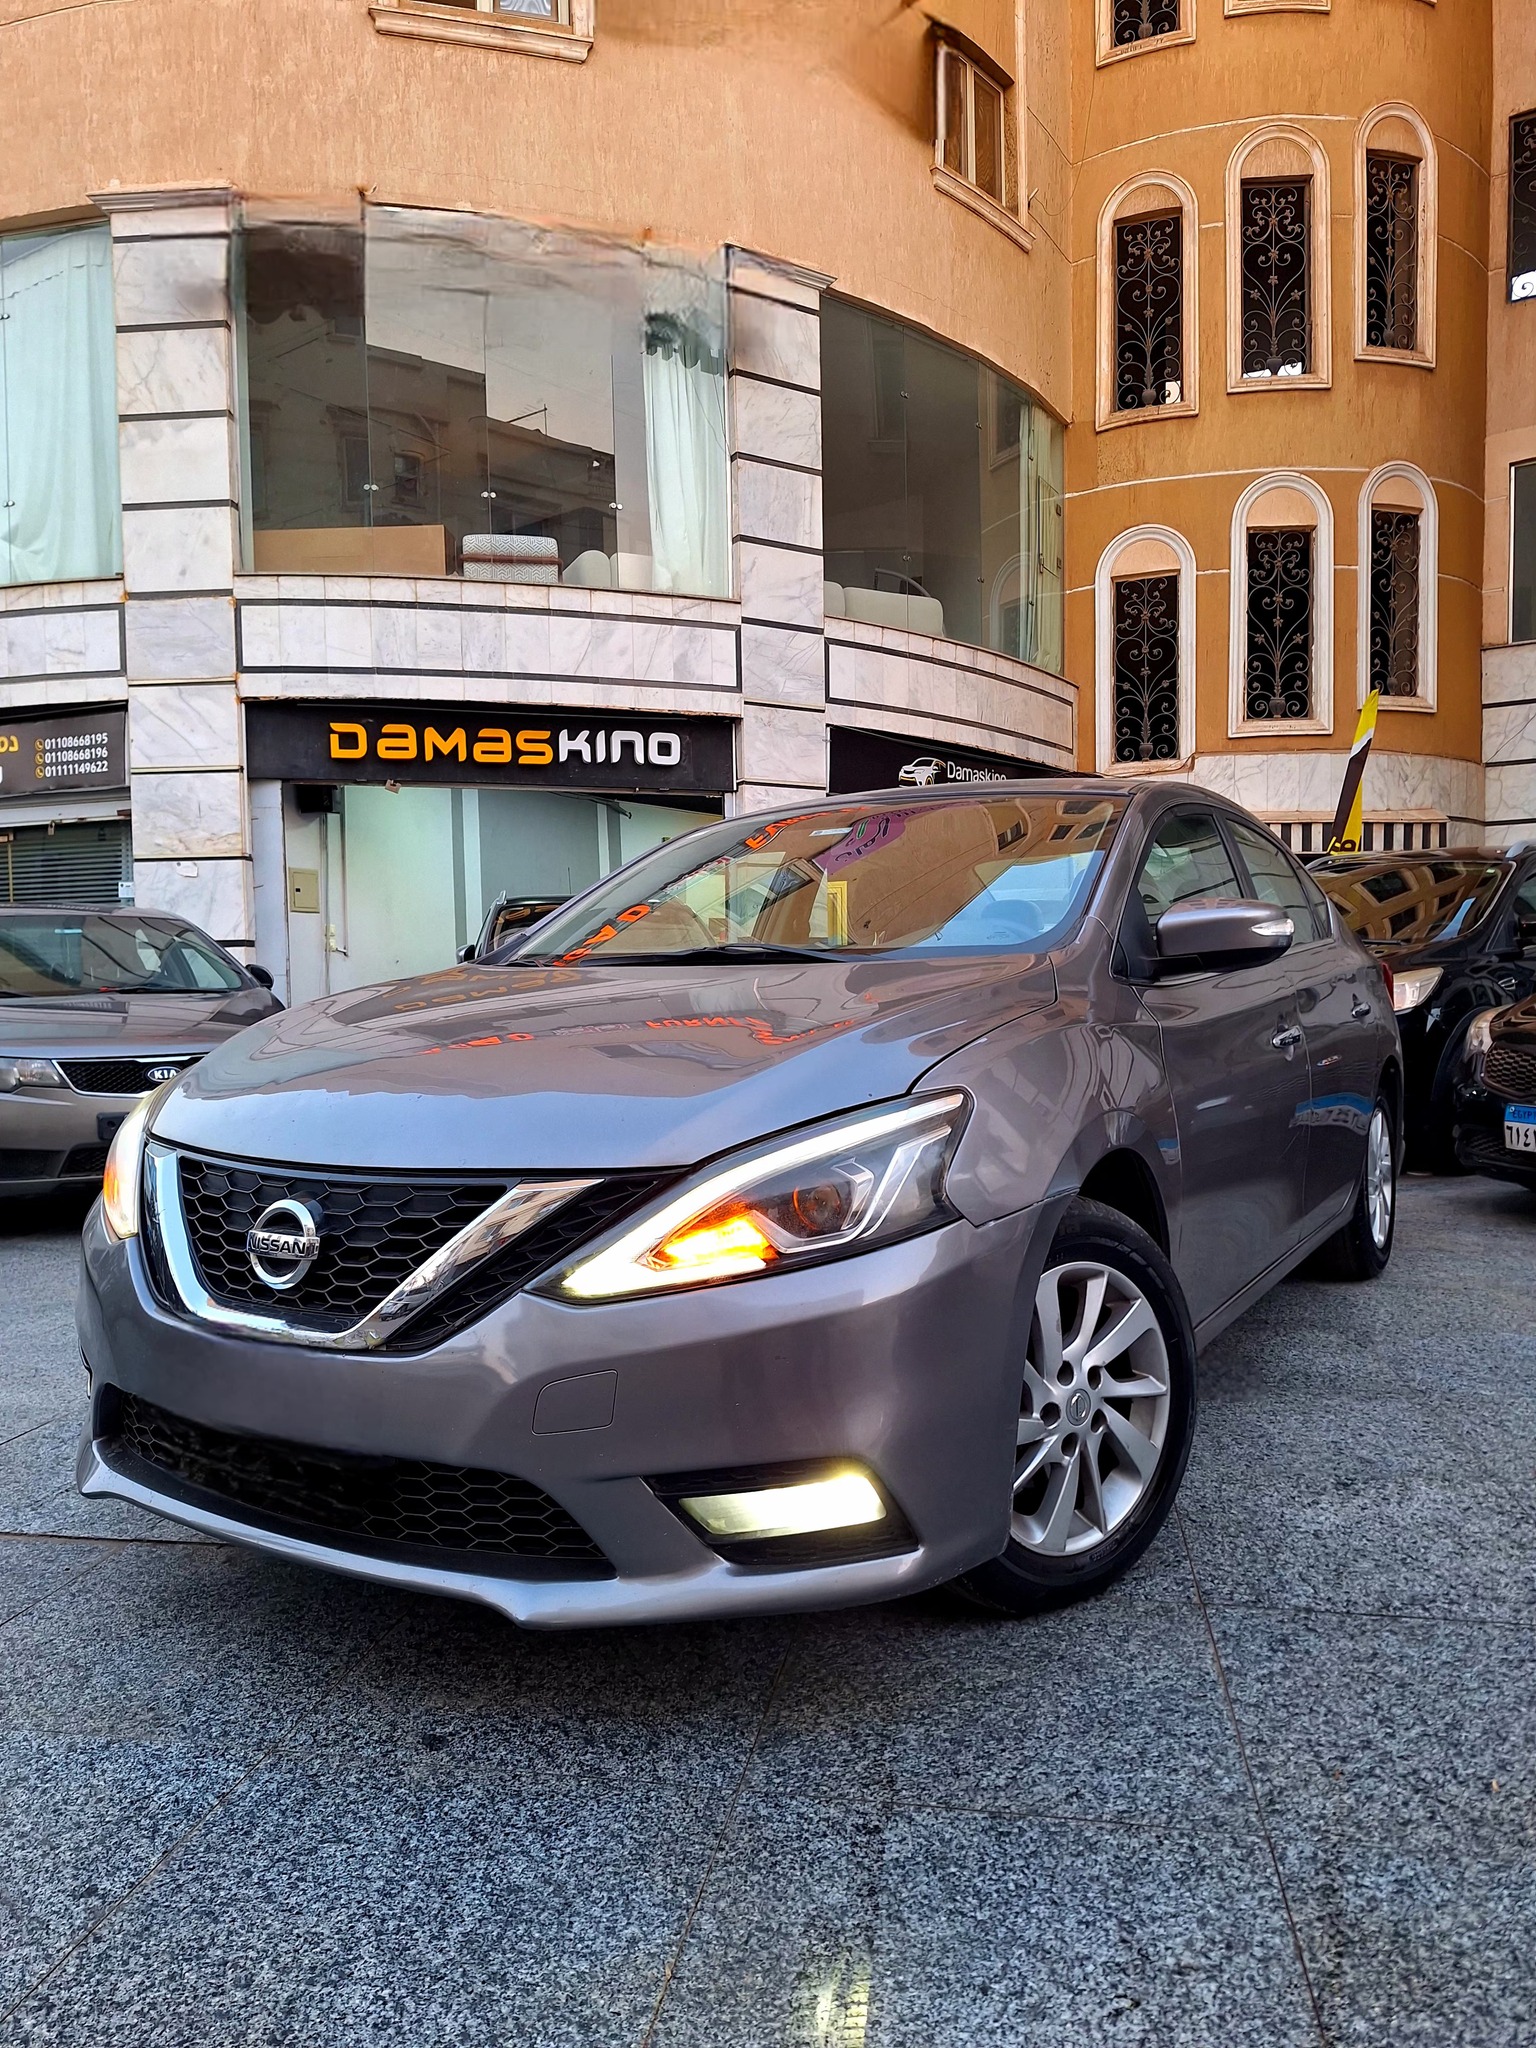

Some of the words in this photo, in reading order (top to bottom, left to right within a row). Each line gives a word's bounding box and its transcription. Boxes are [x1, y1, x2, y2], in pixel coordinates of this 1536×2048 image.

[44, 733, 108, 750] 01108668195
[44, 747, 108, 763] 01108668196
[44, 760, 108, 777] 01111149622
[154, 1069, 177, 1080] KIA
[248, 1236, 306, 1255] NISSAN
